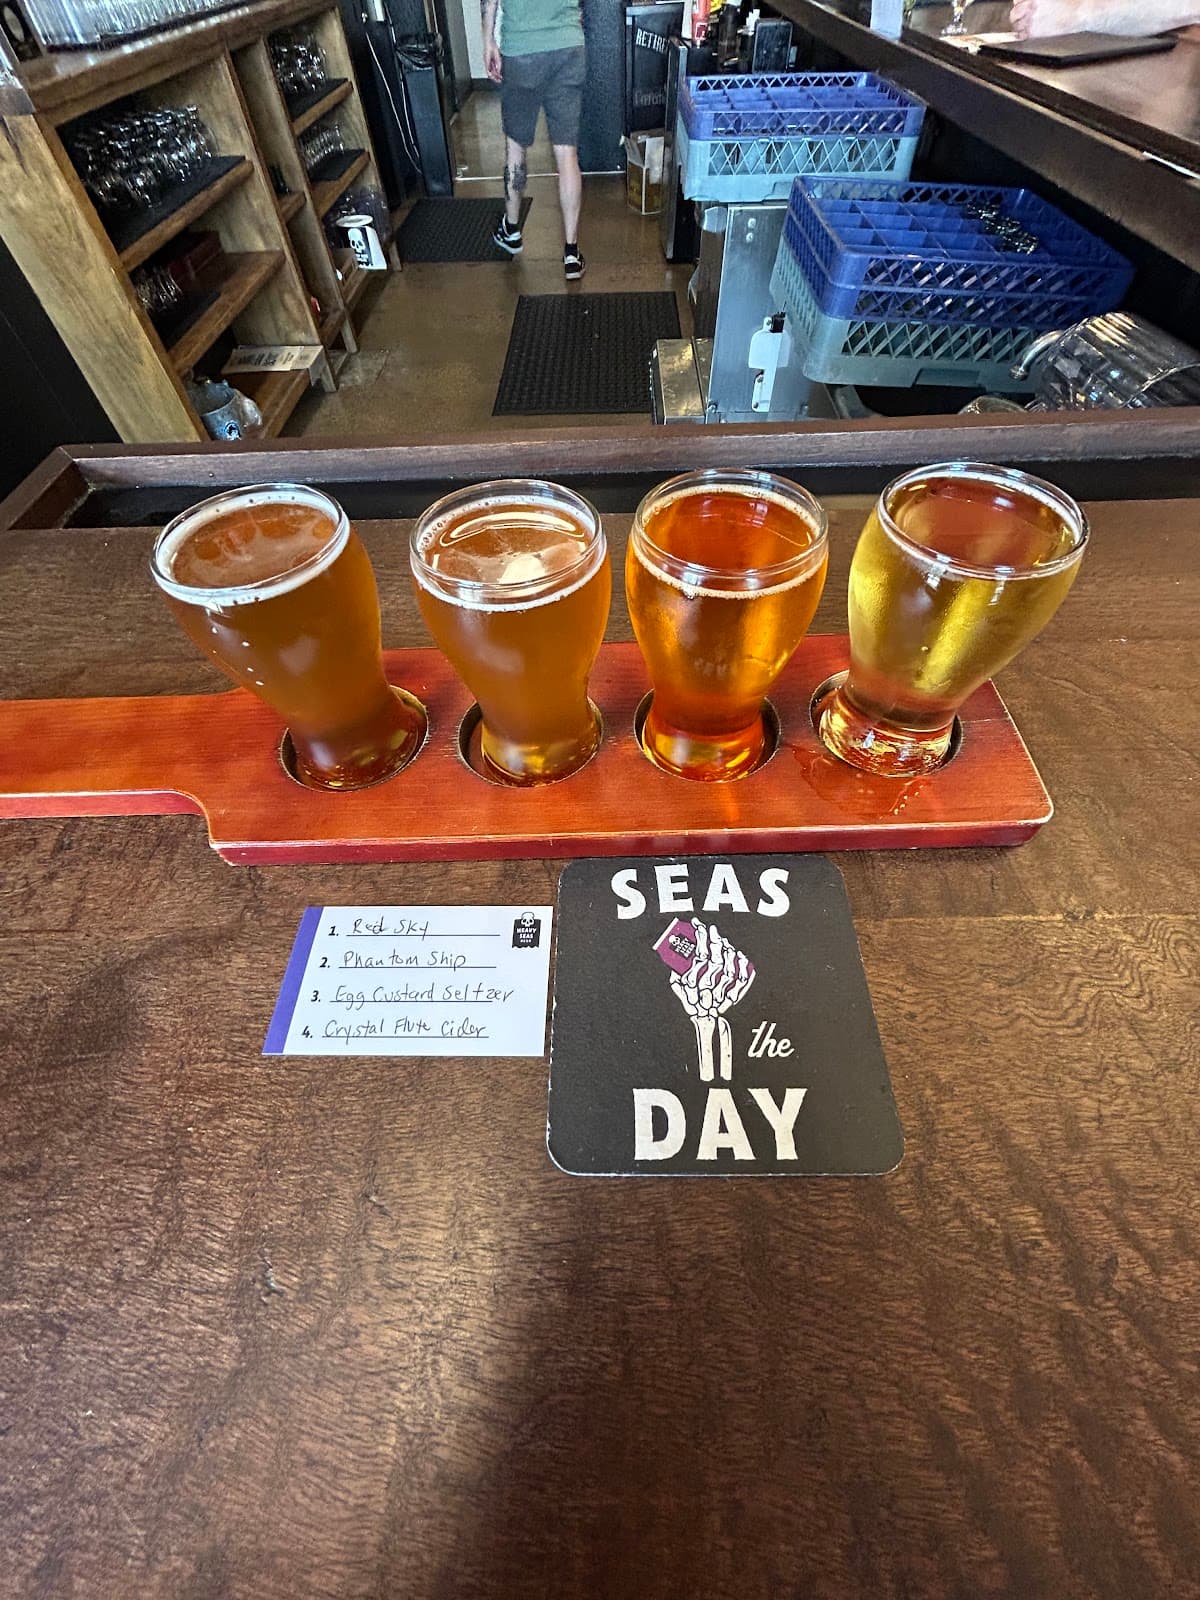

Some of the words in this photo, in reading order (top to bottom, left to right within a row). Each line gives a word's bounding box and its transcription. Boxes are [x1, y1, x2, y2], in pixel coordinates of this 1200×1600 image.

[611, 863, 790, 920] SEAS
[353, 916, 387, 934] Red
[393, 919, 430, 944] Sky
[343, 949, 420, 967] Phantom
[427, 951, 466, 972] Ship
[335, 985, 366, 1011] Egg
[372, 982, 435, 1002] Custard
[444, 982, 514, 1002] Seltzer
[324, 1016, 384, 1045] Crystal
[395, 1017, 431, 1035] Flute
[441, 1017, 487, 1038] Cider
[747, 1020, 796, 1059] the
[633, 1087, 808, 1161] DAY
